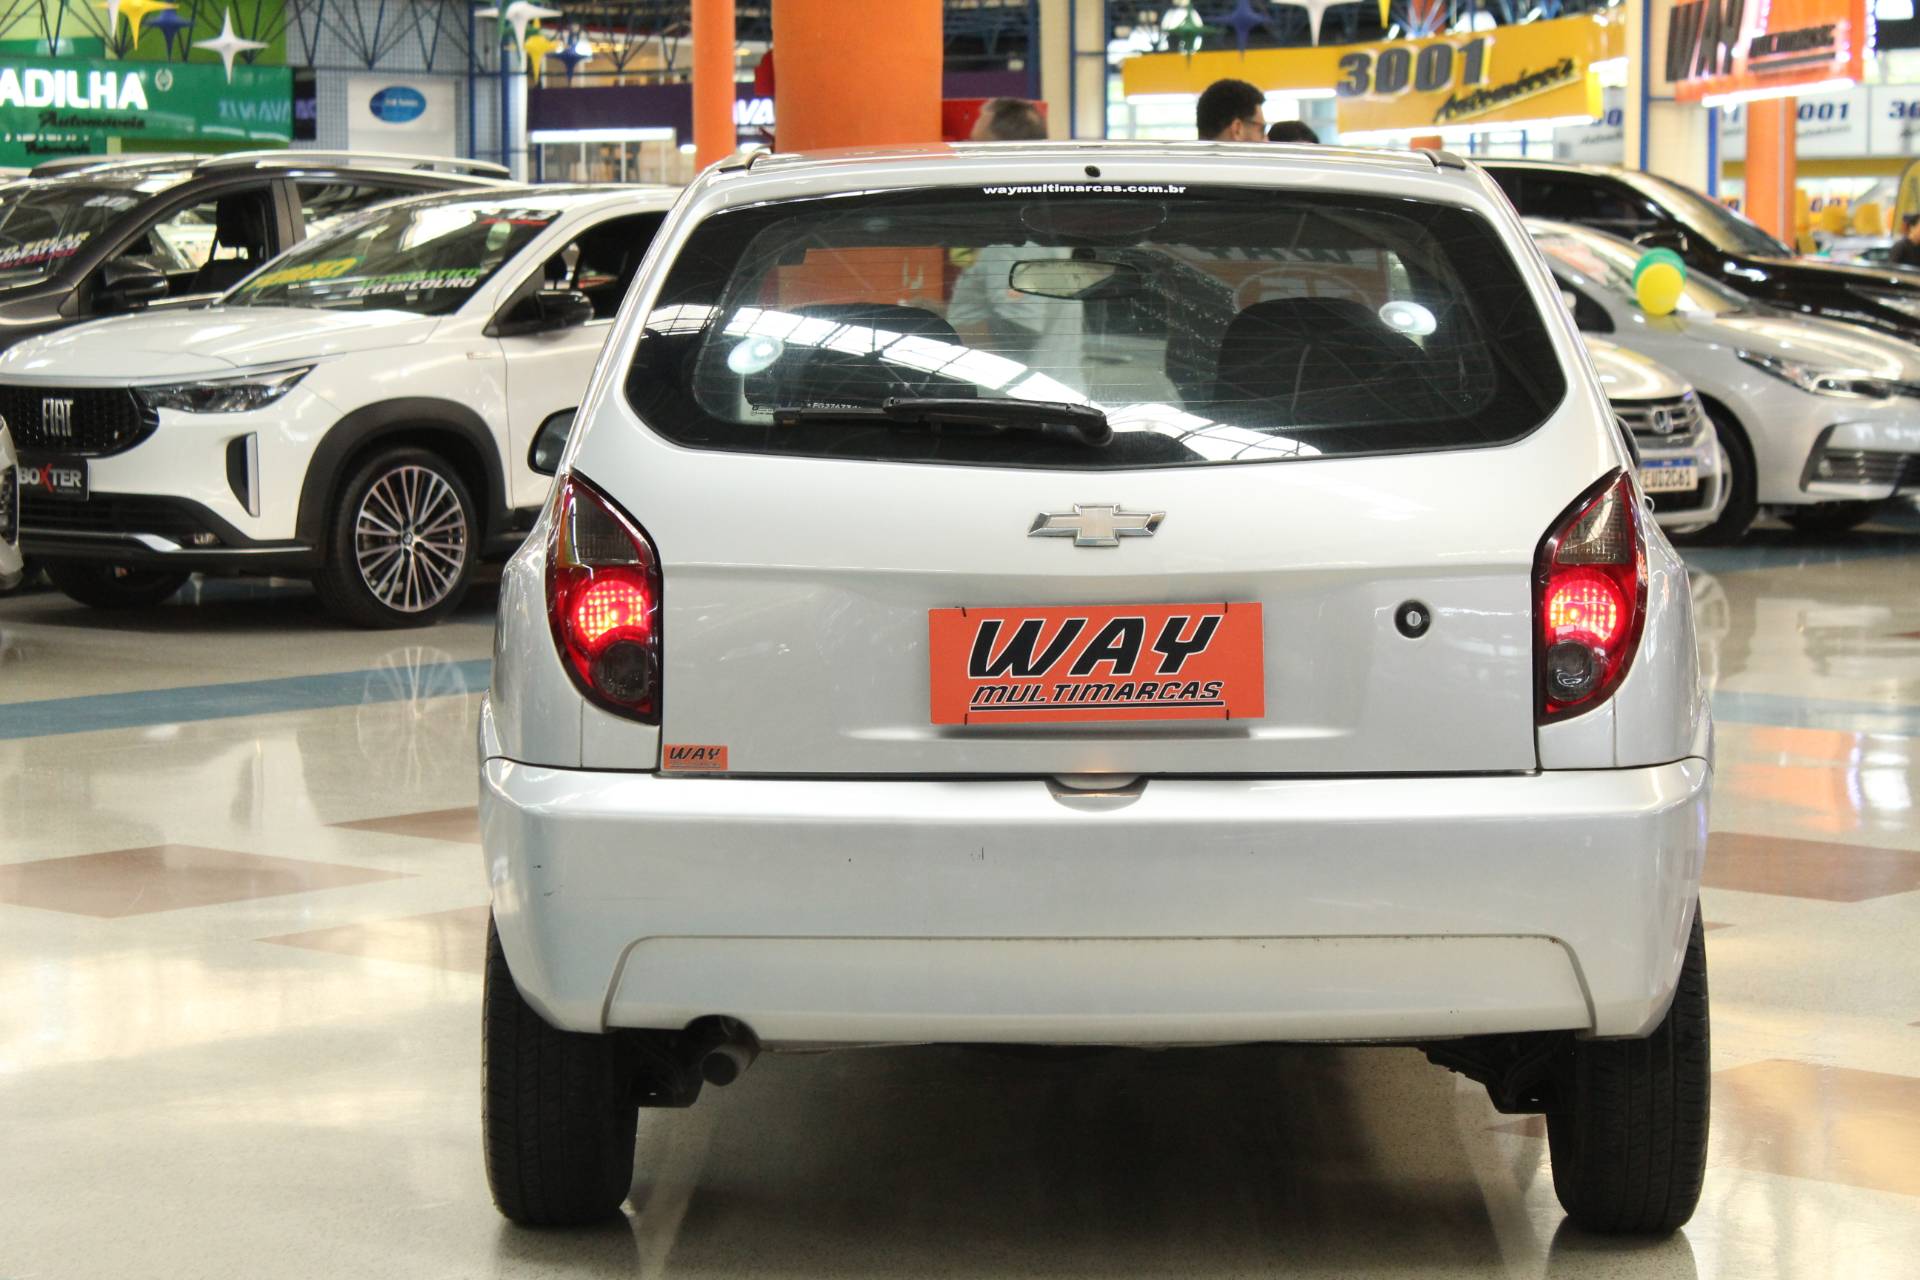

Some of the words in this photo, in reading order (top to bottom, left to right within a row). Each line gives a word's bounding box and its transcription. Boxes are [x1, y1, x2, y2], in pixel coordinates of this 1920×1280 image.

[1336, 37, 1490, 98] 3001
[983, 184, 1186, 195] waymultimarcas.com.br
[42, 398, 74, 437] FIAT
[19, 463, 82, 493] BOXTER
[967, 615, 1224, 679] WAY
[970, 681, 1224, 704] MULTIMARCAS
[669, 746, 721, 760] WAY
